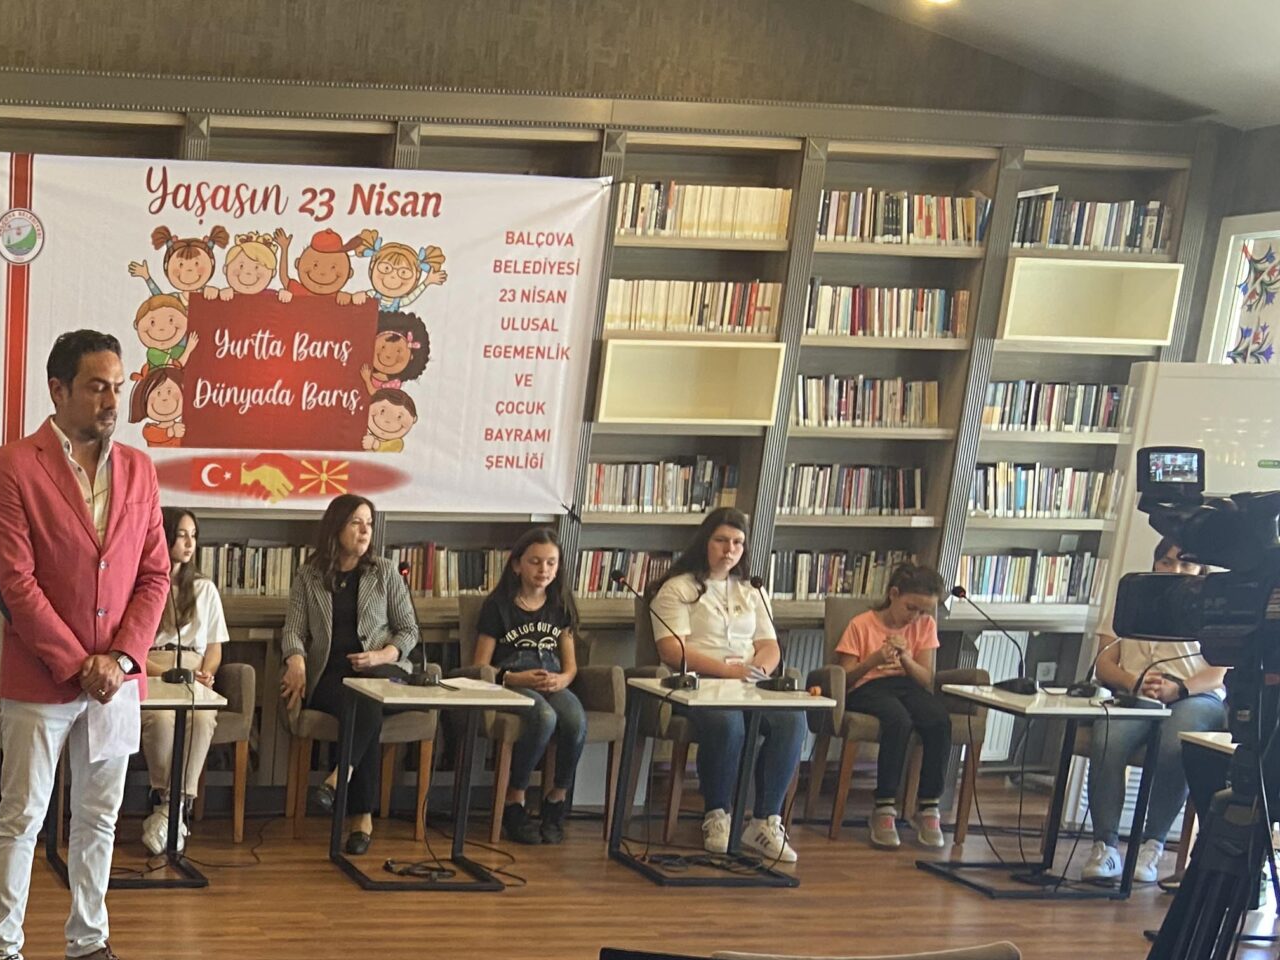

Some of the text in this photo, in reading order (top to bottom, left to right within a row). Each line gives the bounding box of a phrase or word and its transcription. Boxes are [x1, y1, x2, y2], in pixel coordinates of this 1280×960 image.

[145, 166, 442, 225] Yaşasın 23 Nisan
[505, 230, 574, 248] BALÇOVA
[493, 257, 581, 276] BELEDİYESİ
[498, 285, 567, 304] 23 NİSAN
[500, 317, 559, 332] ULUSAL
[214, 328, 353, 366] Yurtta Barış
[483, 343, 570, 360] EGEMENLİK
[515, 373, 533, 387] VE
[193, 377, 364, 415] Dünyada Barış.
[495, 401, 546, 416] ÇOCUK
[484, 428, 551, 443] BAYRAMI
[485, 453, 545, 470] ŞENLİĞİ
[518, 622, 535, 635] LOG
[537, 621, 552, 634] OUT
